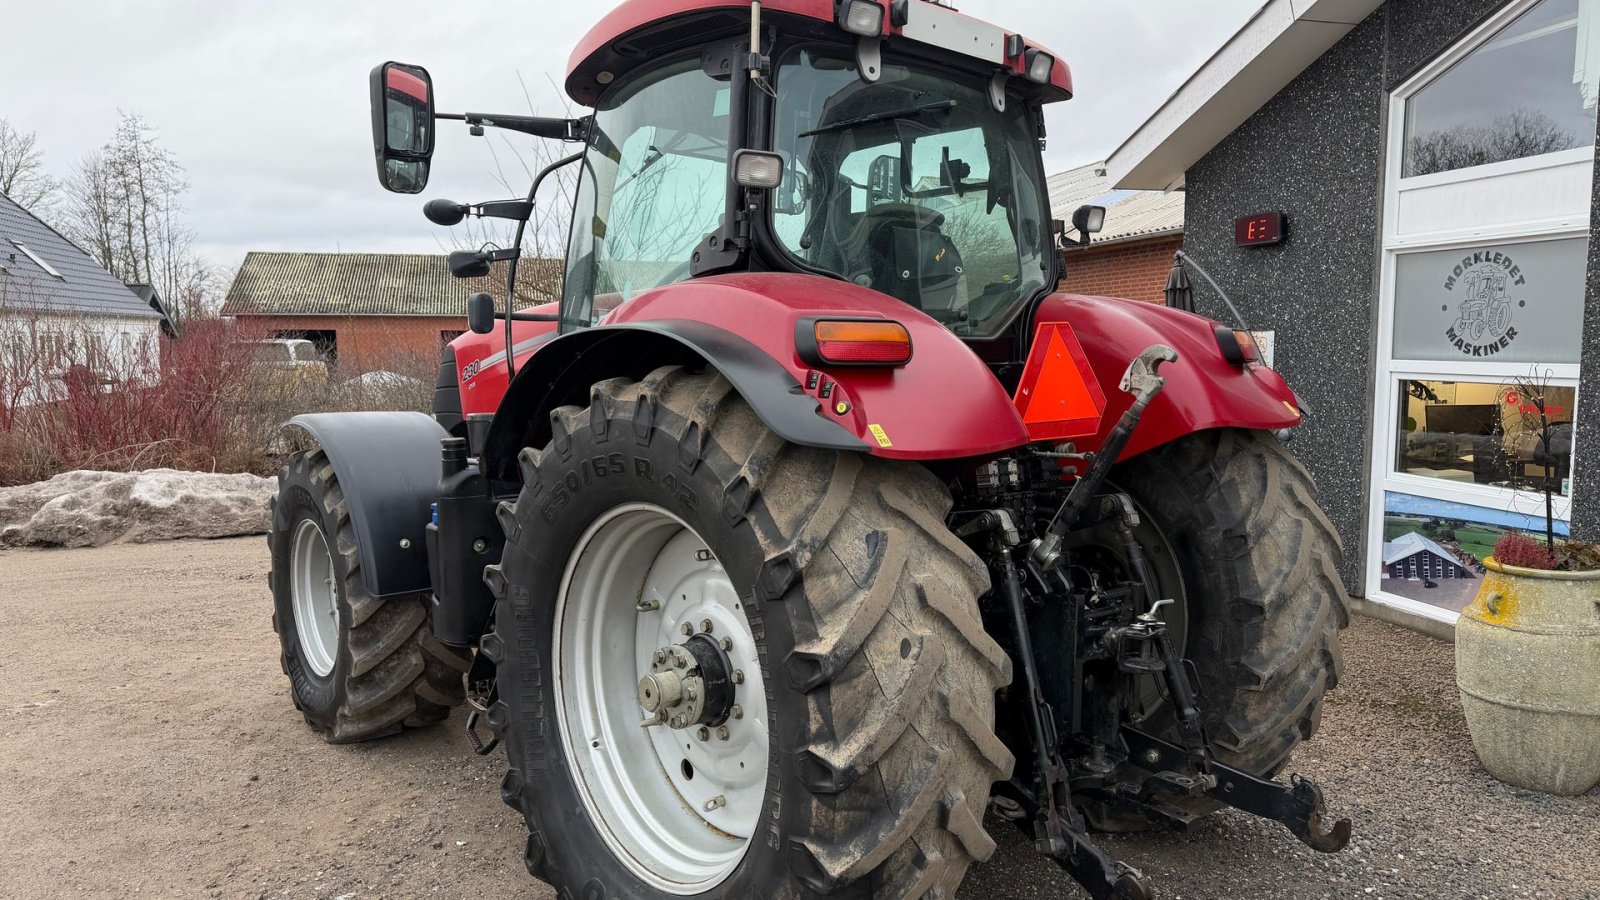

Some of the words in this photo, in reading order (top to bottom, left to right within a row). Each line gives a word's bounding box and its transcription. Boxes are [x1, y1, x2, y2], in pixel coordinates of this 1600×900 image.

[1445, 326, 1519, 357] MASKINER
[462, 359, 480, 383] 230
[541, 452, 625, 525] 650/65
[634, 455, 655, 483] R
[662, 472, 698, 512] 42
